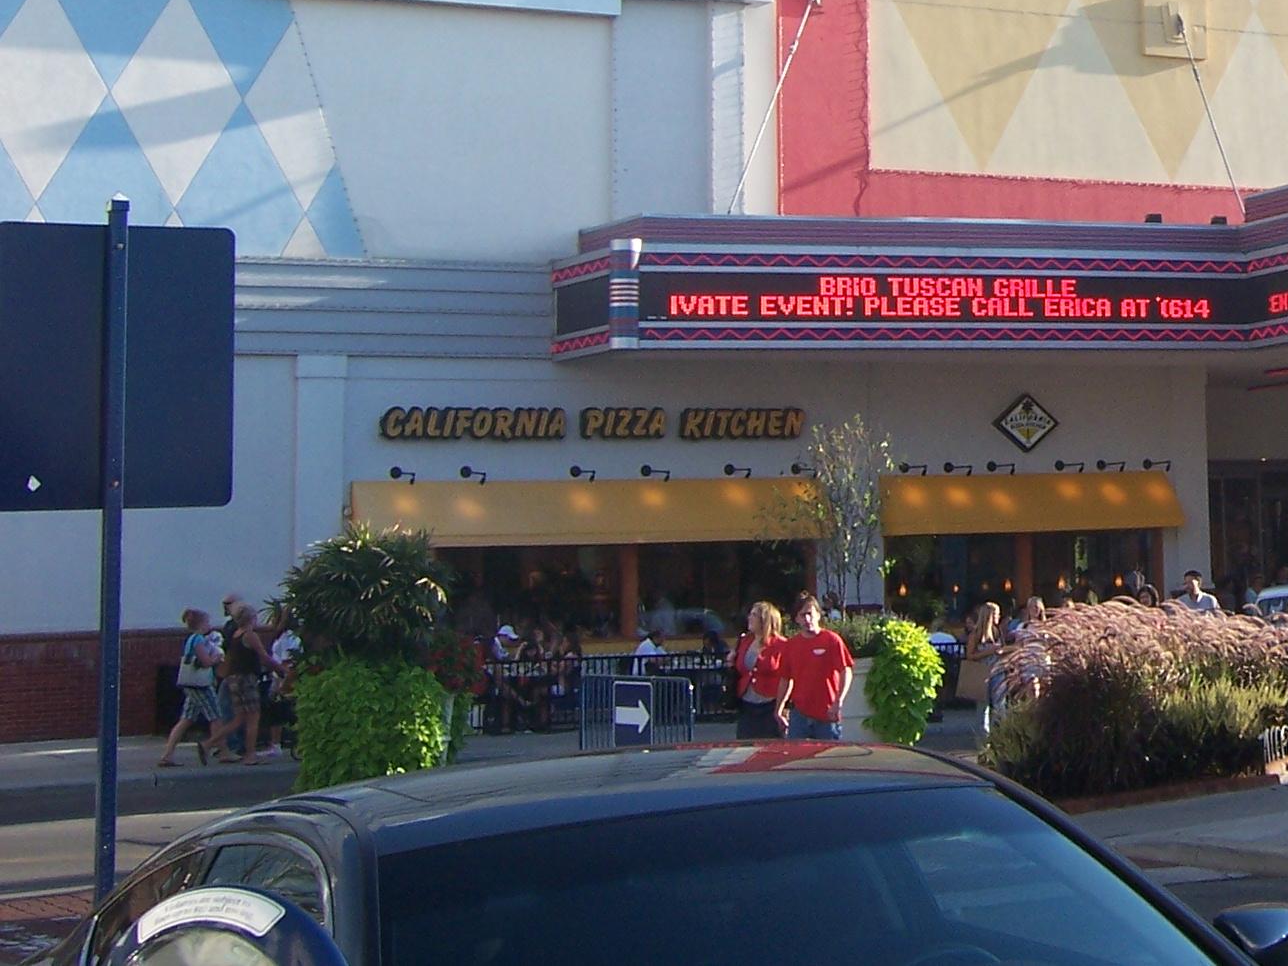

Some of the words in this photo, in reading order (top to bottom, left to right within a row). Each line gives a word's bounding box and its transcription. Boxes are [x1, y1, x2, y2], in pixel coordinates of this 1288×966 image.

[888, 277, 983, 298] TUSCAN
[993, 278, 1077, 299] GRILLE
[670, 294, 749, 316] IVATE
[760, 295, 854, 317] EVENT!
[864, 296, 962, 317] PLEASE
[971, 297, 1034, 317] CALL
[1043, 297, 1112, 318] ERICA
[1120, 298, 1150, 318] AT
[381, 406, 566, 438] CALIFORNIA
[581, 407, 666, 439] PIZZA
[681, 407, 805, 440] KITCHEN
